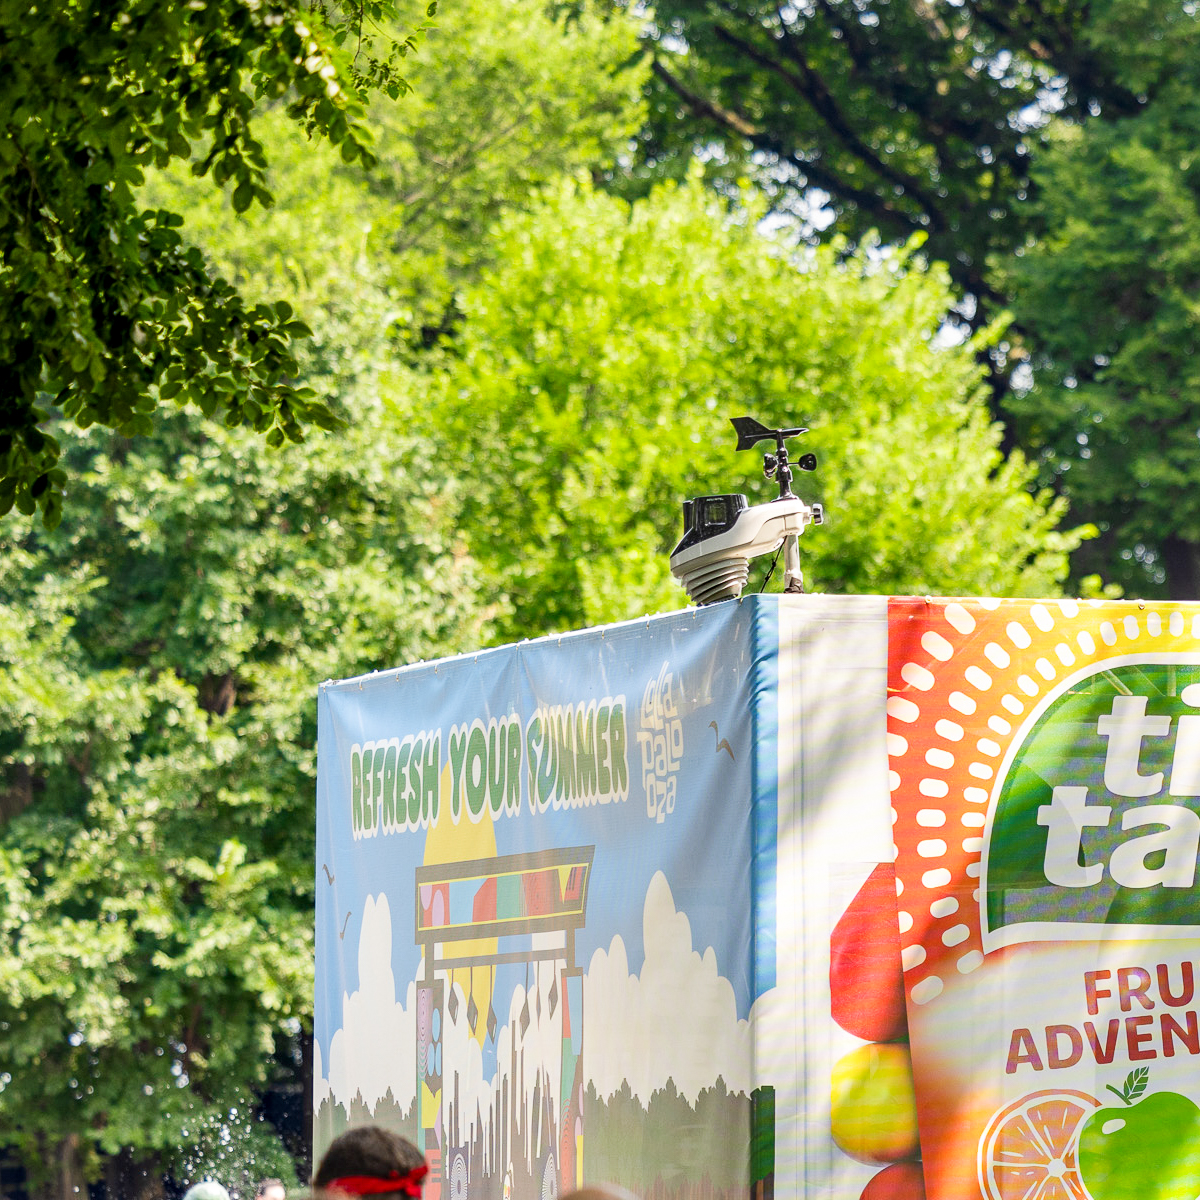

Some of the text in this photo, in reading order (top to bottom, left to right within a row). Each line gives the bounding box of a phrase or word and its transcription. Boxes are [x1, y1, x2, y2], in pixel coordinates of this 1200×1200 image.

[351, 695, 630, 841] REFRESH YOUR SUMMER
